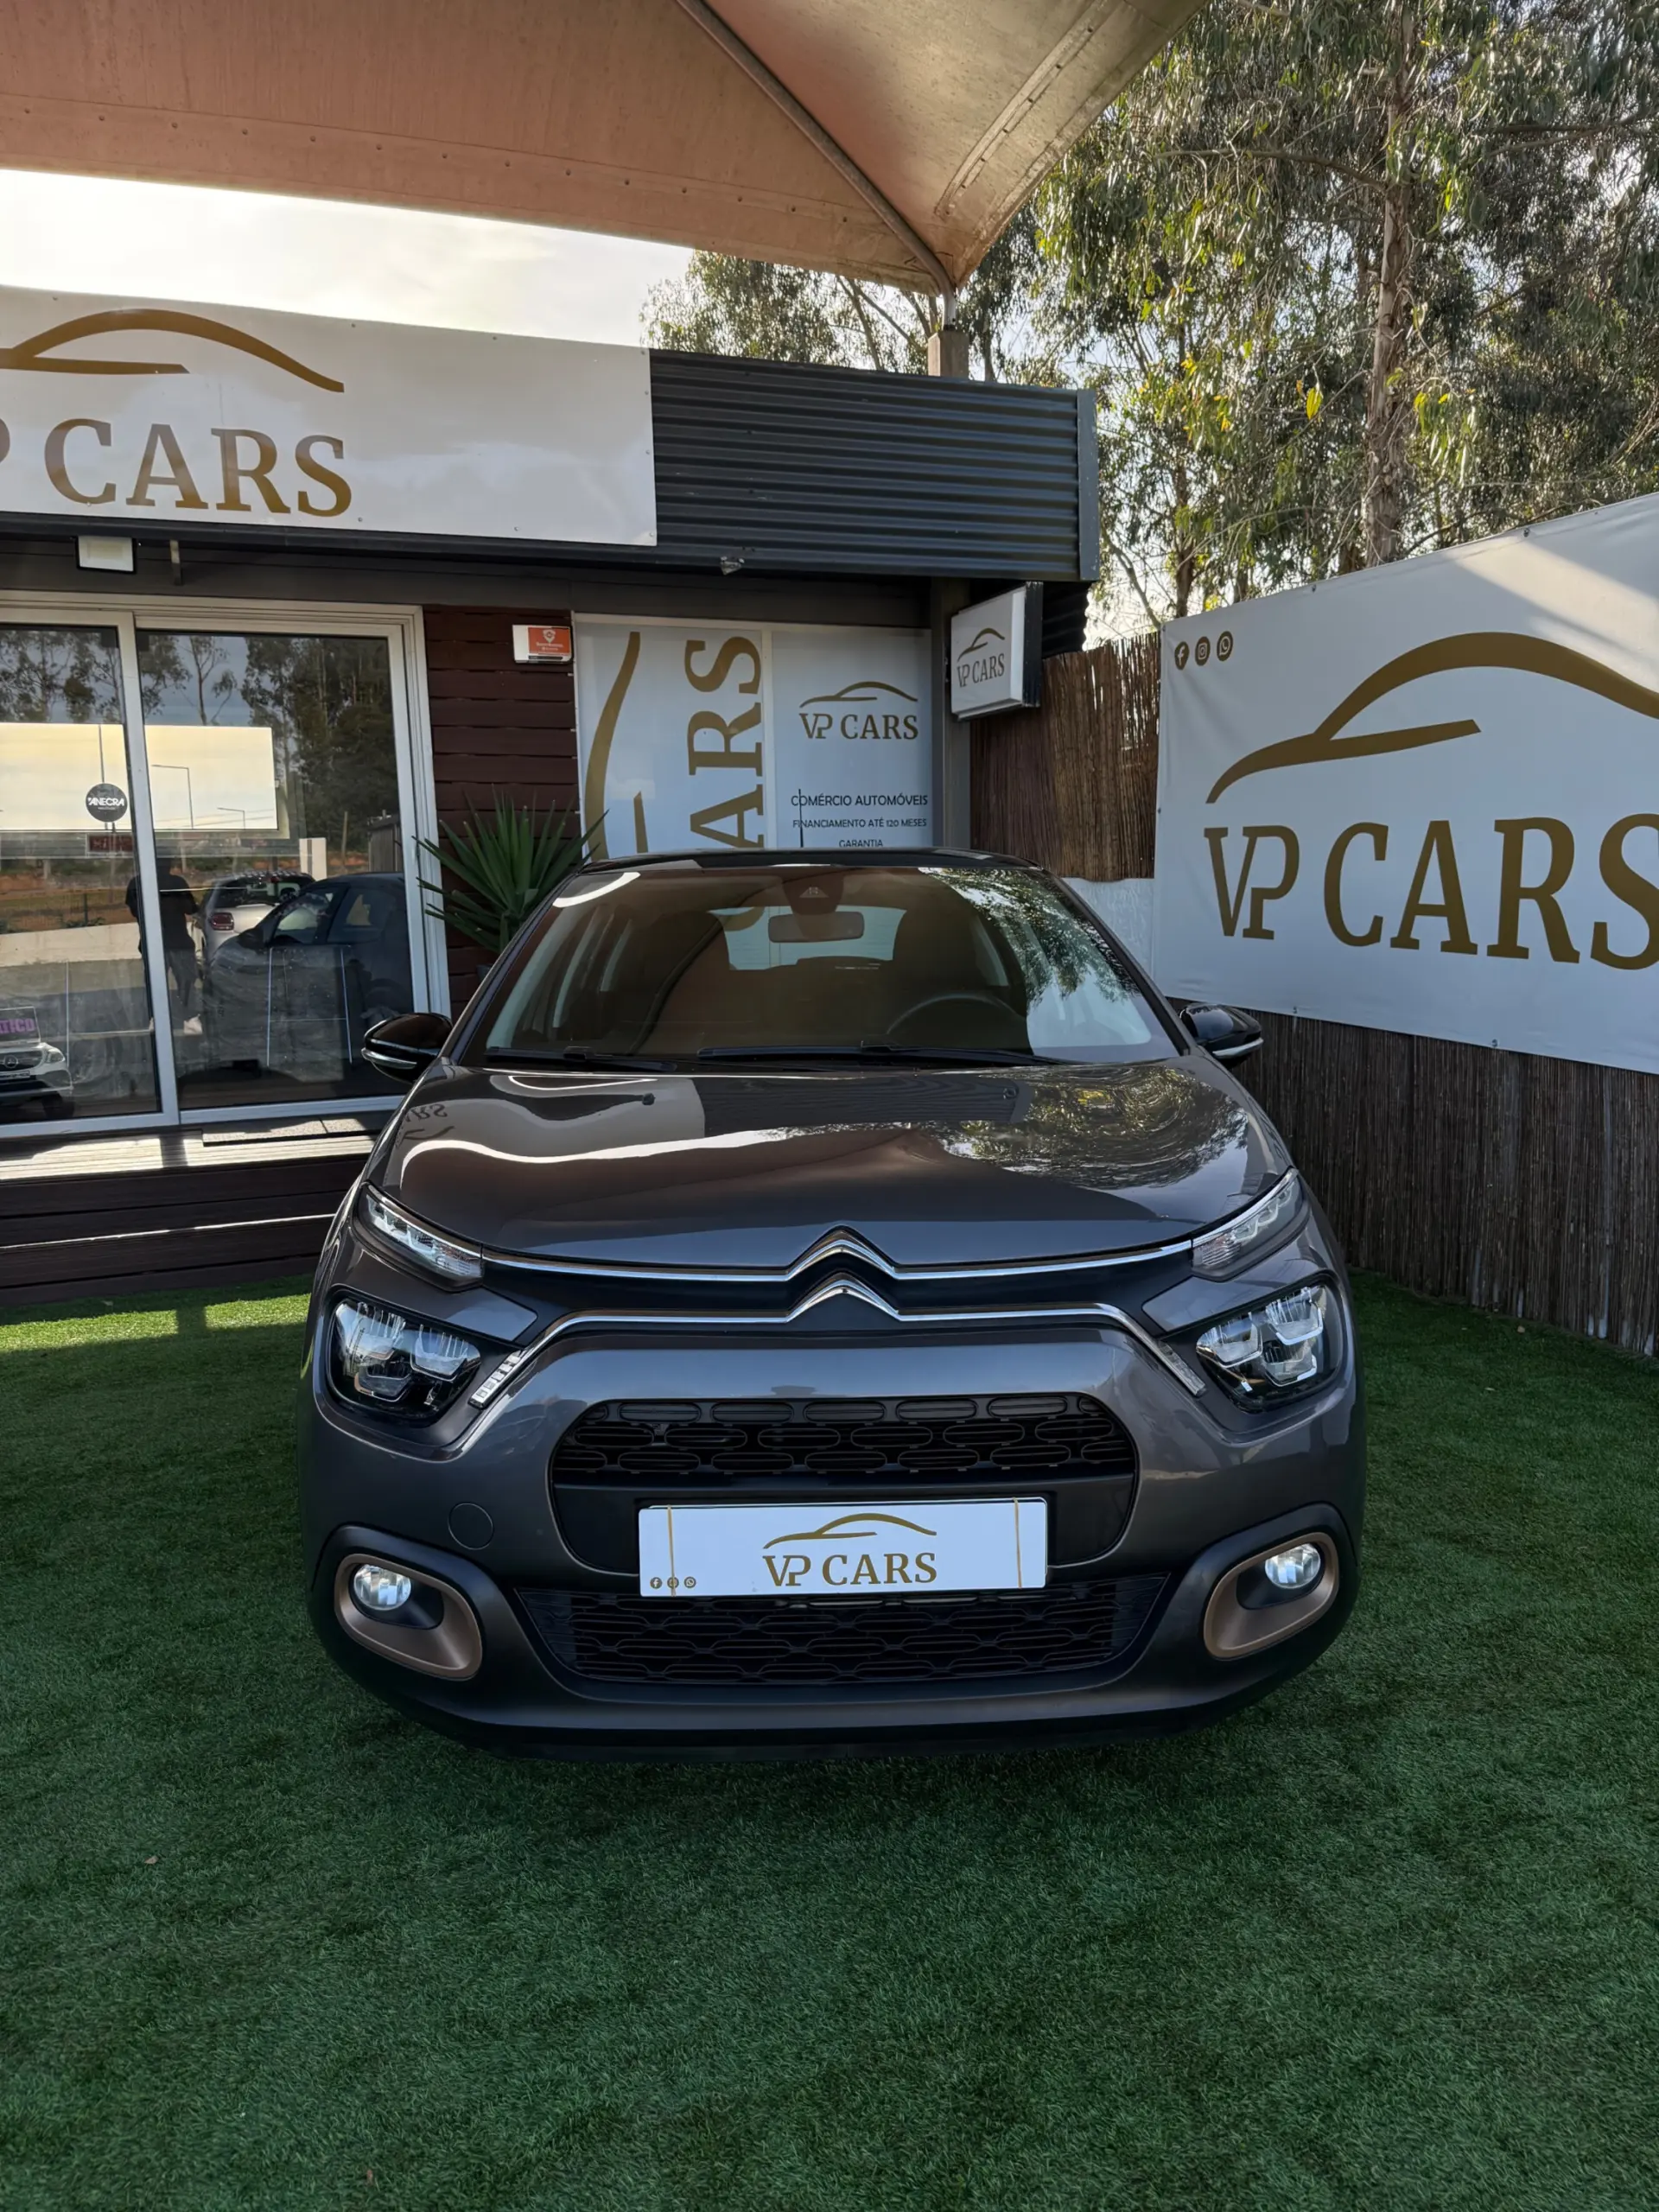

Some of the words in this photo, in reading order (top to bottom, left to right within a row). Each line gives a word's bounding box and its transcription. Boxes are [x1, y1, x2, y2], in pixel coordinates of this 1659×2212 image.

[44, 418, 353, 517] CARS
[957, 664, 969, 688] VP
[972, 653, 1005, 683] CARS
[798, 713, 833, 739] VP
[840, 714, 918, 740] CARS
[684, 636, 765, 849] ARS
[791, 793, 852, 806] COMÉRCIO
[855, 792, 928, 806] AUTOMÓVEIS
[792, 819, 866, 828] FINANCIAMENTO
[868, 817, 884, 828] ATÉ
[901, 818, 927, 828] MESES
[839, 839, 883, 848] GARANTIA
[1204, 825, 1300, 940] VP
[1324, 813, 1659, 970] CARS
[0, 1018, 35, 1034] TICO
[762, 1555, 811, 1586] VP
[822, 1553, 938, 1586] CARS
